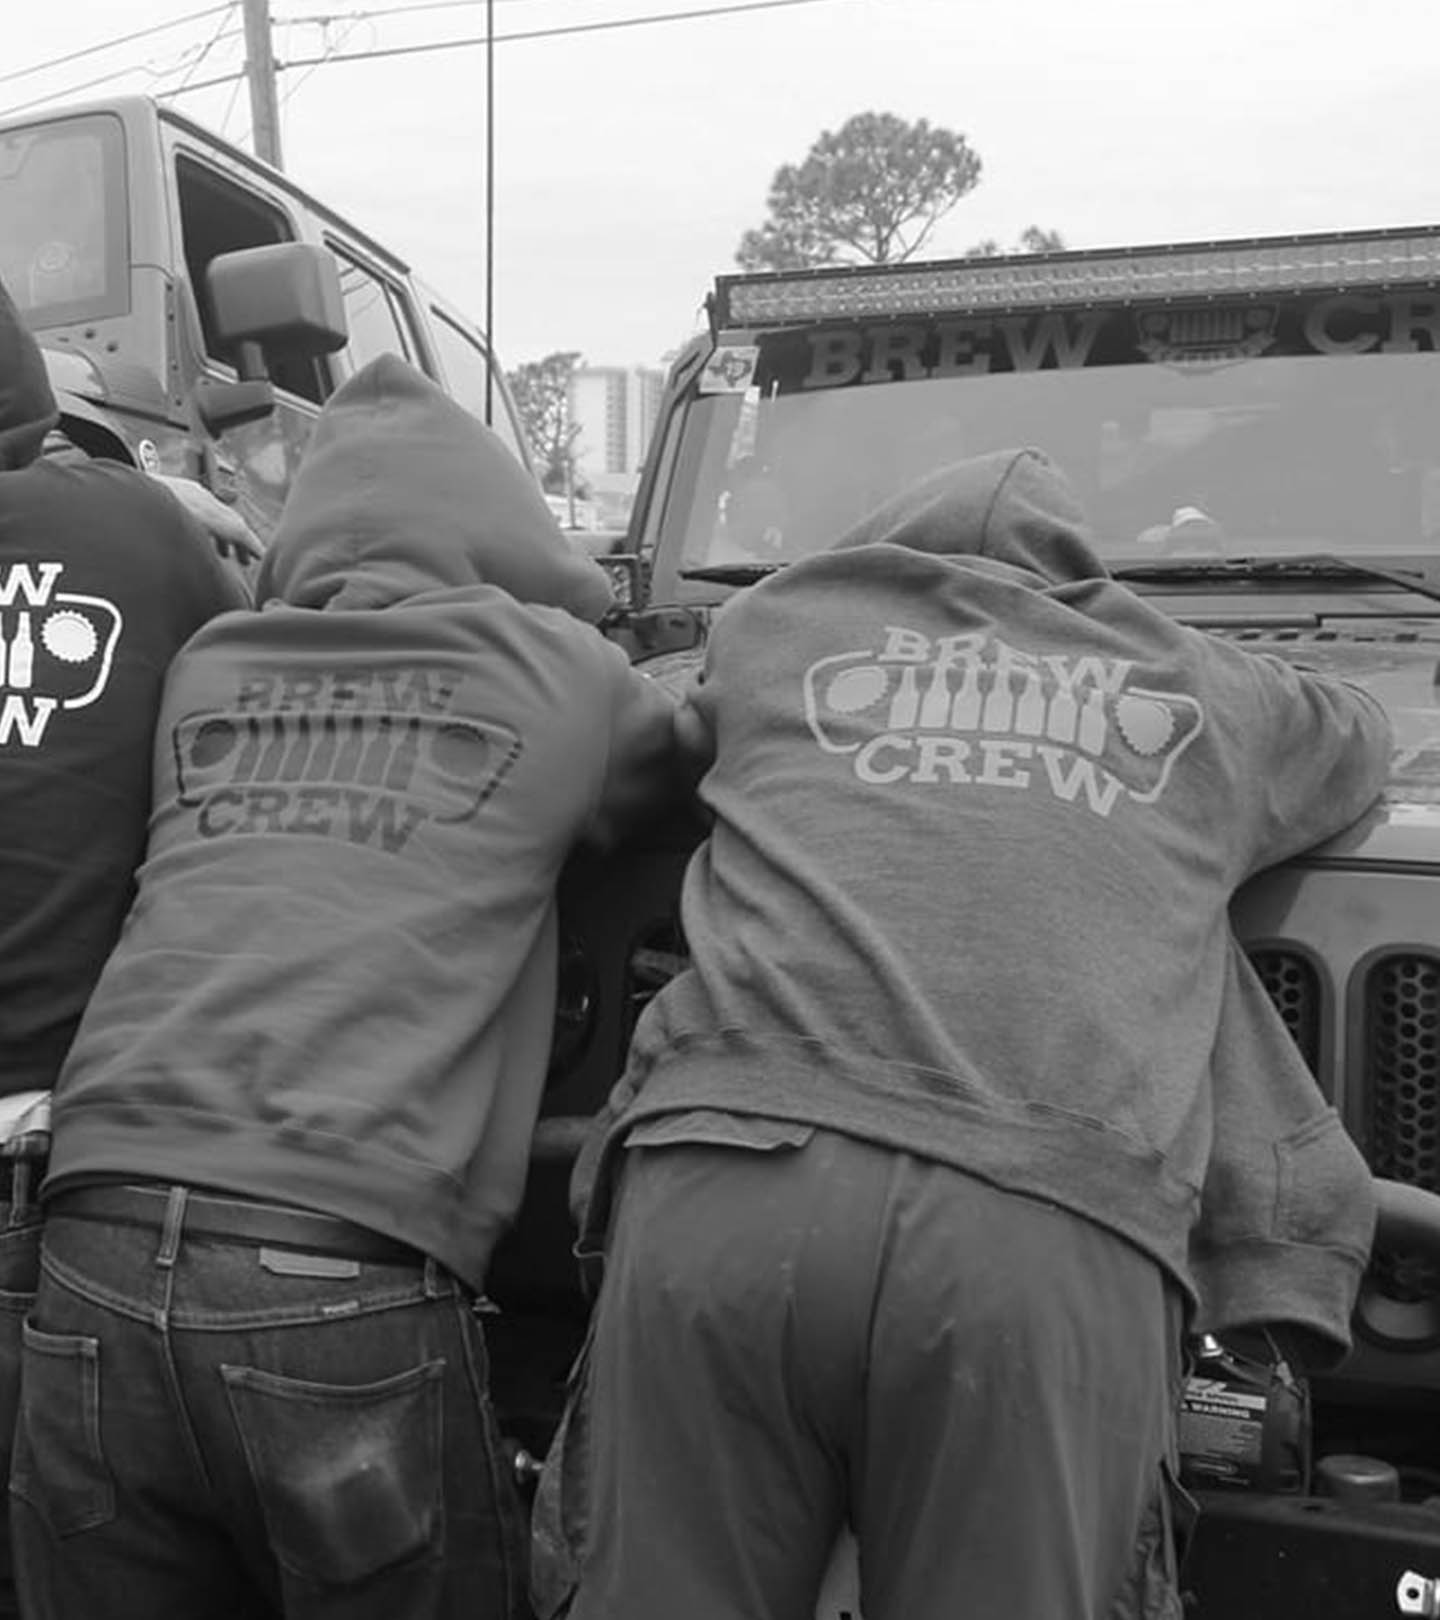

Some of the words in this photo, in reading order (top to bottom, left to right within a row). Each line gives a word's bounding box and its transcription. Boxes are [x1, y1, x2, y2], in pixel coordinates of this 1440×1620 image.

[804, 310, 1108, 388] BREW
[1303, 297, 1440, 355] CR
[877, 625, 1140, 697] BREW
[853, 733, 1125, 817] CREW
[196, 787, 429, 854] CREW
